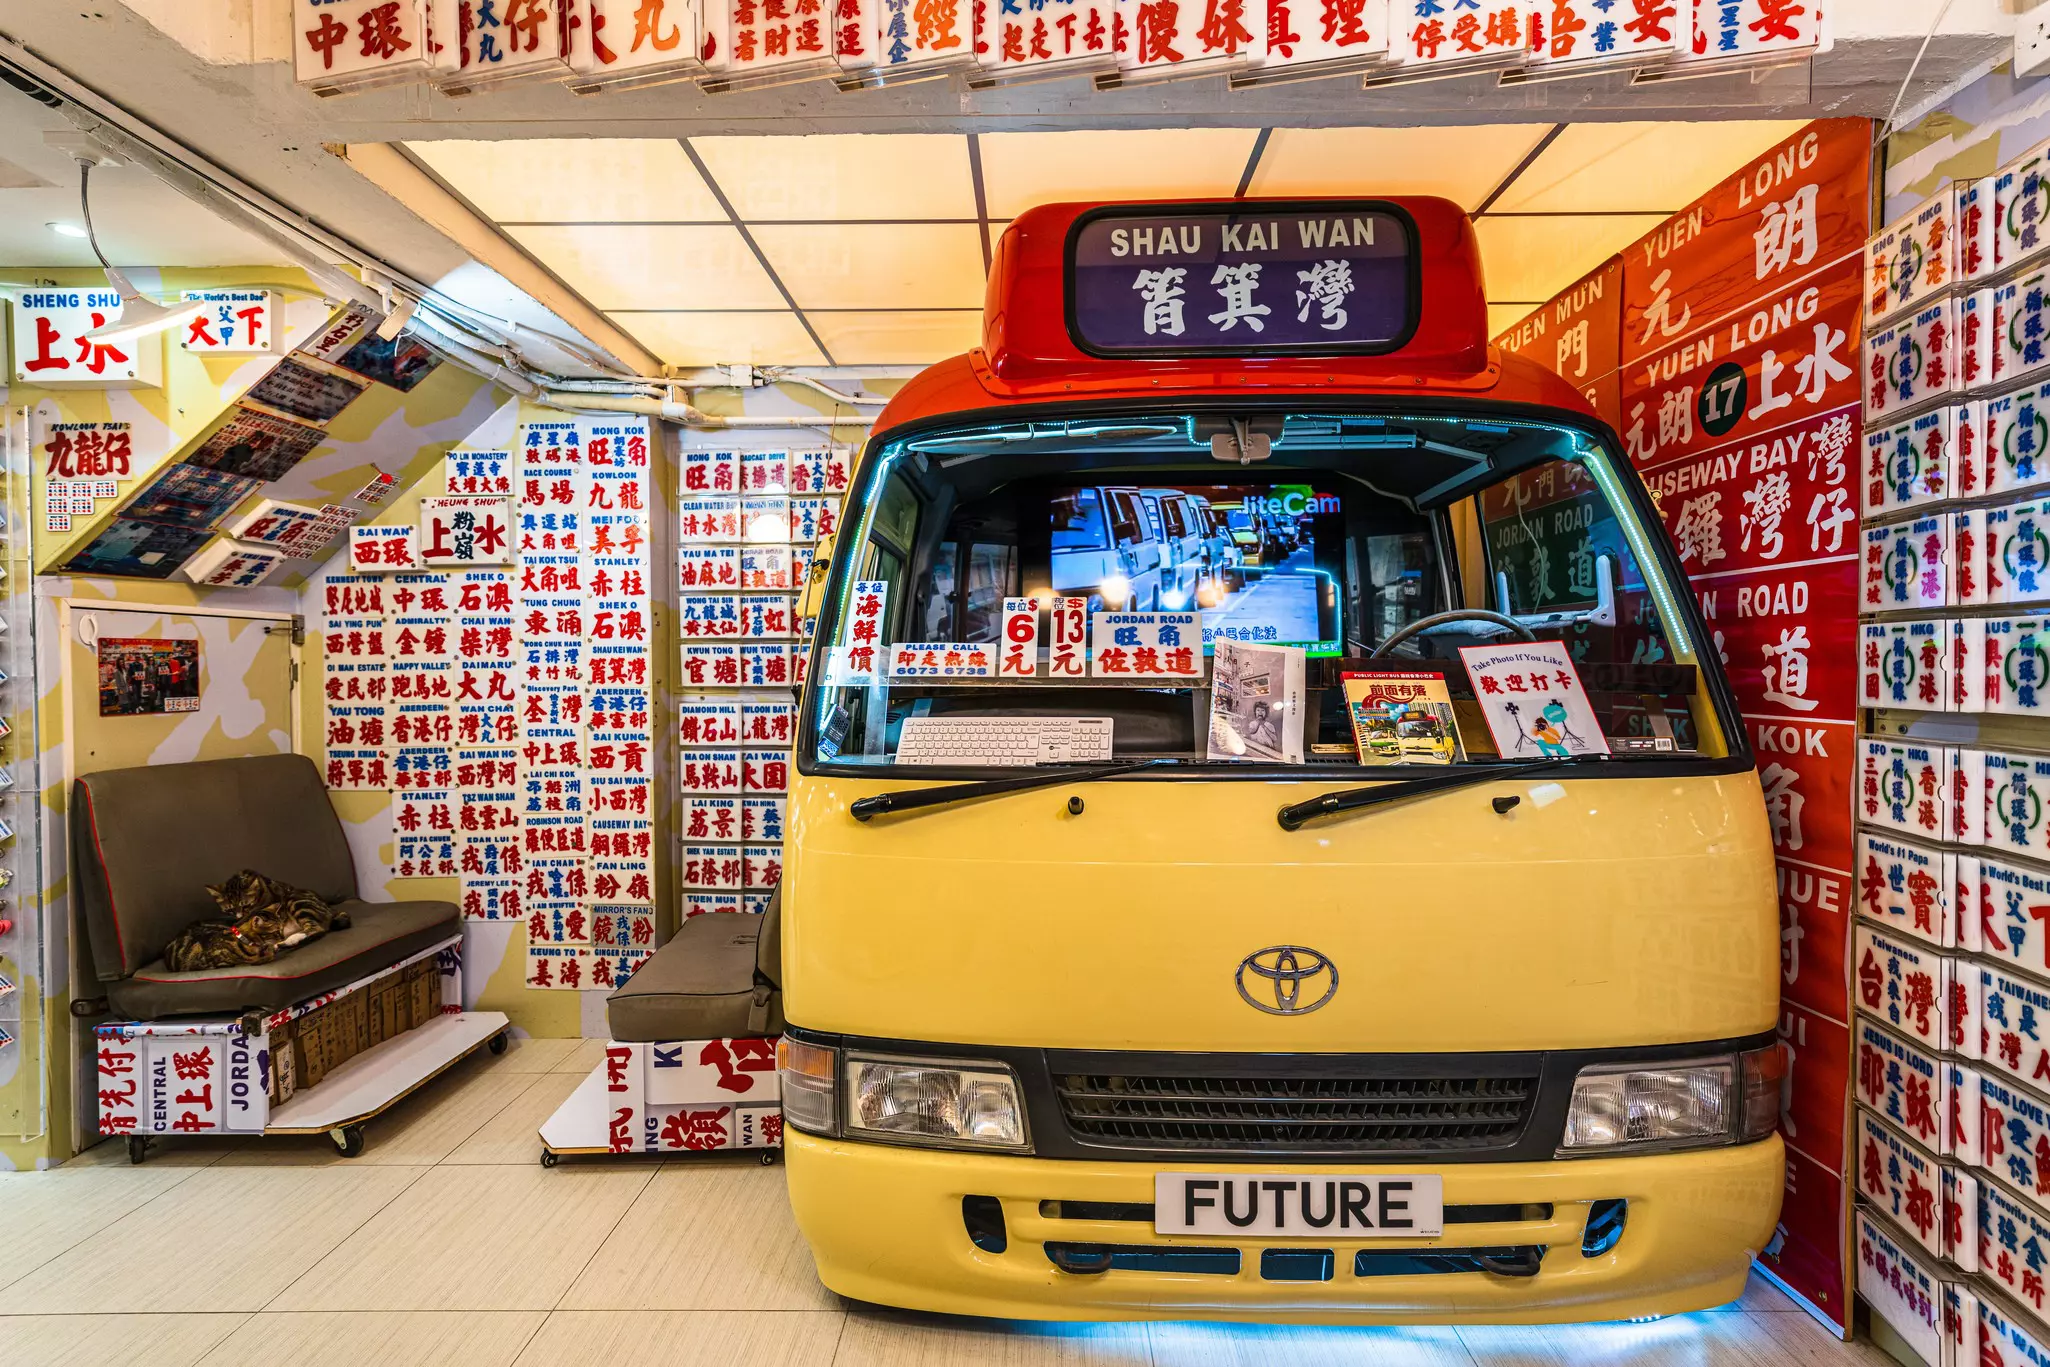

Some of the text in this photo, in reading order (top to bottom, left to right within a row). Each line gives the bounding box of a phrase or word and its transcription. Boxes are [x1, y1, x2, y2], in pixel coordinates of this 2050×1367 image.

[306, 2, 411, 69] 中環
[1644, 132, 1819, 267] YUEN LONG
[1111, 218, 1375, 256] SHAU KAI WAN
[1873, 201, 1941, 254] ENG HKG
[1640, 183, 1819, 346] 元朗
[1926, 216, 1946, 286] 香港
[23, 294, 120, 308] SHENG SHU
[1132, 259, 1355, 336] 筲箕灣
[1557, 276, 1602, 324] MUN
[219, 305, 234, 345] 父甲
[1647, 287, 1819, 388] YUEN LONG
[1871, 306, 1941, 350] TWN HKG
[24, 313, 129, 374] 上水
[1748, 323, 1852, 421] 上水
[1871, 353, 1886, 410] 台灣
[1706, 376, 1741, 422] 17
[51, 423, 97, 431] KOWLOON
[1625, 385, 1693, 460] 元朗
[1869, 414, 1939, 447] USA HKG
[45, 431, 131, 477] 九龍仔
[687, 453, 709, 461] MONG
[456, 462, 501, 477] 寶蓮寺
[686, 463, 733, 491] 旺角
[1806, 414, 1855, 552] 灣仔
[1869, 448, 1884, 507] 美國
[448, 478, 510, 493] 天壇大佛
[522, 480, 575, 505] 馬場
[589, 482, 643, 509] 九龍
[422, 514, 506, 558] 上水
[452, 511, 475, 559] 粉嶺
[684, 513, 736, 536] 清水灣
[1497, 504, 1593, 548] JORDAN ROAD
[1868, 520, 1938, 542] SGP HKG
[355, 538, 414, 566] 西環
[395, 575, 447, 583] CENTRAL
[589, 570, 645, 597] 赤柱
[682, 561, 736, 587] 油麻地
[856, 583, 884, 593] 每位
[1867, 545, 1882, 604] 新加坡
[393, 588, 448, 612] 中環
[458, 582, 513, 612] 石澳
[1738, 581, 1808, 617] ROAD
[684, 620, 738, 636] 黃大仙
[848, 594, 882, 672] 海鮮價
[1008, 614, 1034, 643] 6
[1054, 610, 1083, 643] 13
[1115, 625, 1180, 646] 旺角
[1867, 624, 1934, 637] FRA HKG
[459, 627, 512, 657] 柴灣
[898, 651, 988, 666] 即走熱線
[1003, 644, 1034, 675] 元
[1052, 644, 1083, 675] 元
[1099, 647, 1197, 674] 佐敦道
[1471, 662, 1491, 671] Take
[1490, 656, 1514, 665] Photo
[1524, 654, 1541, 662] You
[1544, 656, 1562, 666] Like
[1866, 642, 1880, 700] 法國
[457, 671, 515, 701] 大丸
[1370, 685, 1426, 696] 前面有落
[1480, 670, 1572, 694] 歡迎打卡
[330, 707, 384, 716] YAU TONG
[328, 718, 384, 745] 油塘
[391, 715, 452, 743] 香港仔
[1758, 725, 1828, 757] KOK
[523, 741, 581, 766] 中上環
[590, 742, 646, 772] 西貢
[1869, 744, 1928, 762] SFO HKG
[683, 763, 738, 789] 馬鞍山
[1864, 758, 1879, 818] 三藩市
[589, 785, 647, 814] 小西灣
[687, 809, 735, 838] 荔景
[684, 859, 740, 886] 石蔭邨
[1989, 866, 2043, 889] World's Best
[2006, 890, 2026, 958] 父甲
[1872, 936, 1920, 965] Taiwanese
[1987, 992, 2039, 1041] 我是
[1863, 1027, 1934, 1078] JESUS IS LORD
[154, 1057, 166, 1131] CENTRAL
[173, 1046, 215, 1132] 中上環
[743, 1115, 752, 1146] WAN
[2007, 1118, 2033, 1187] 愛你
[1185, 1180, 1413, 1228] FUTURE
